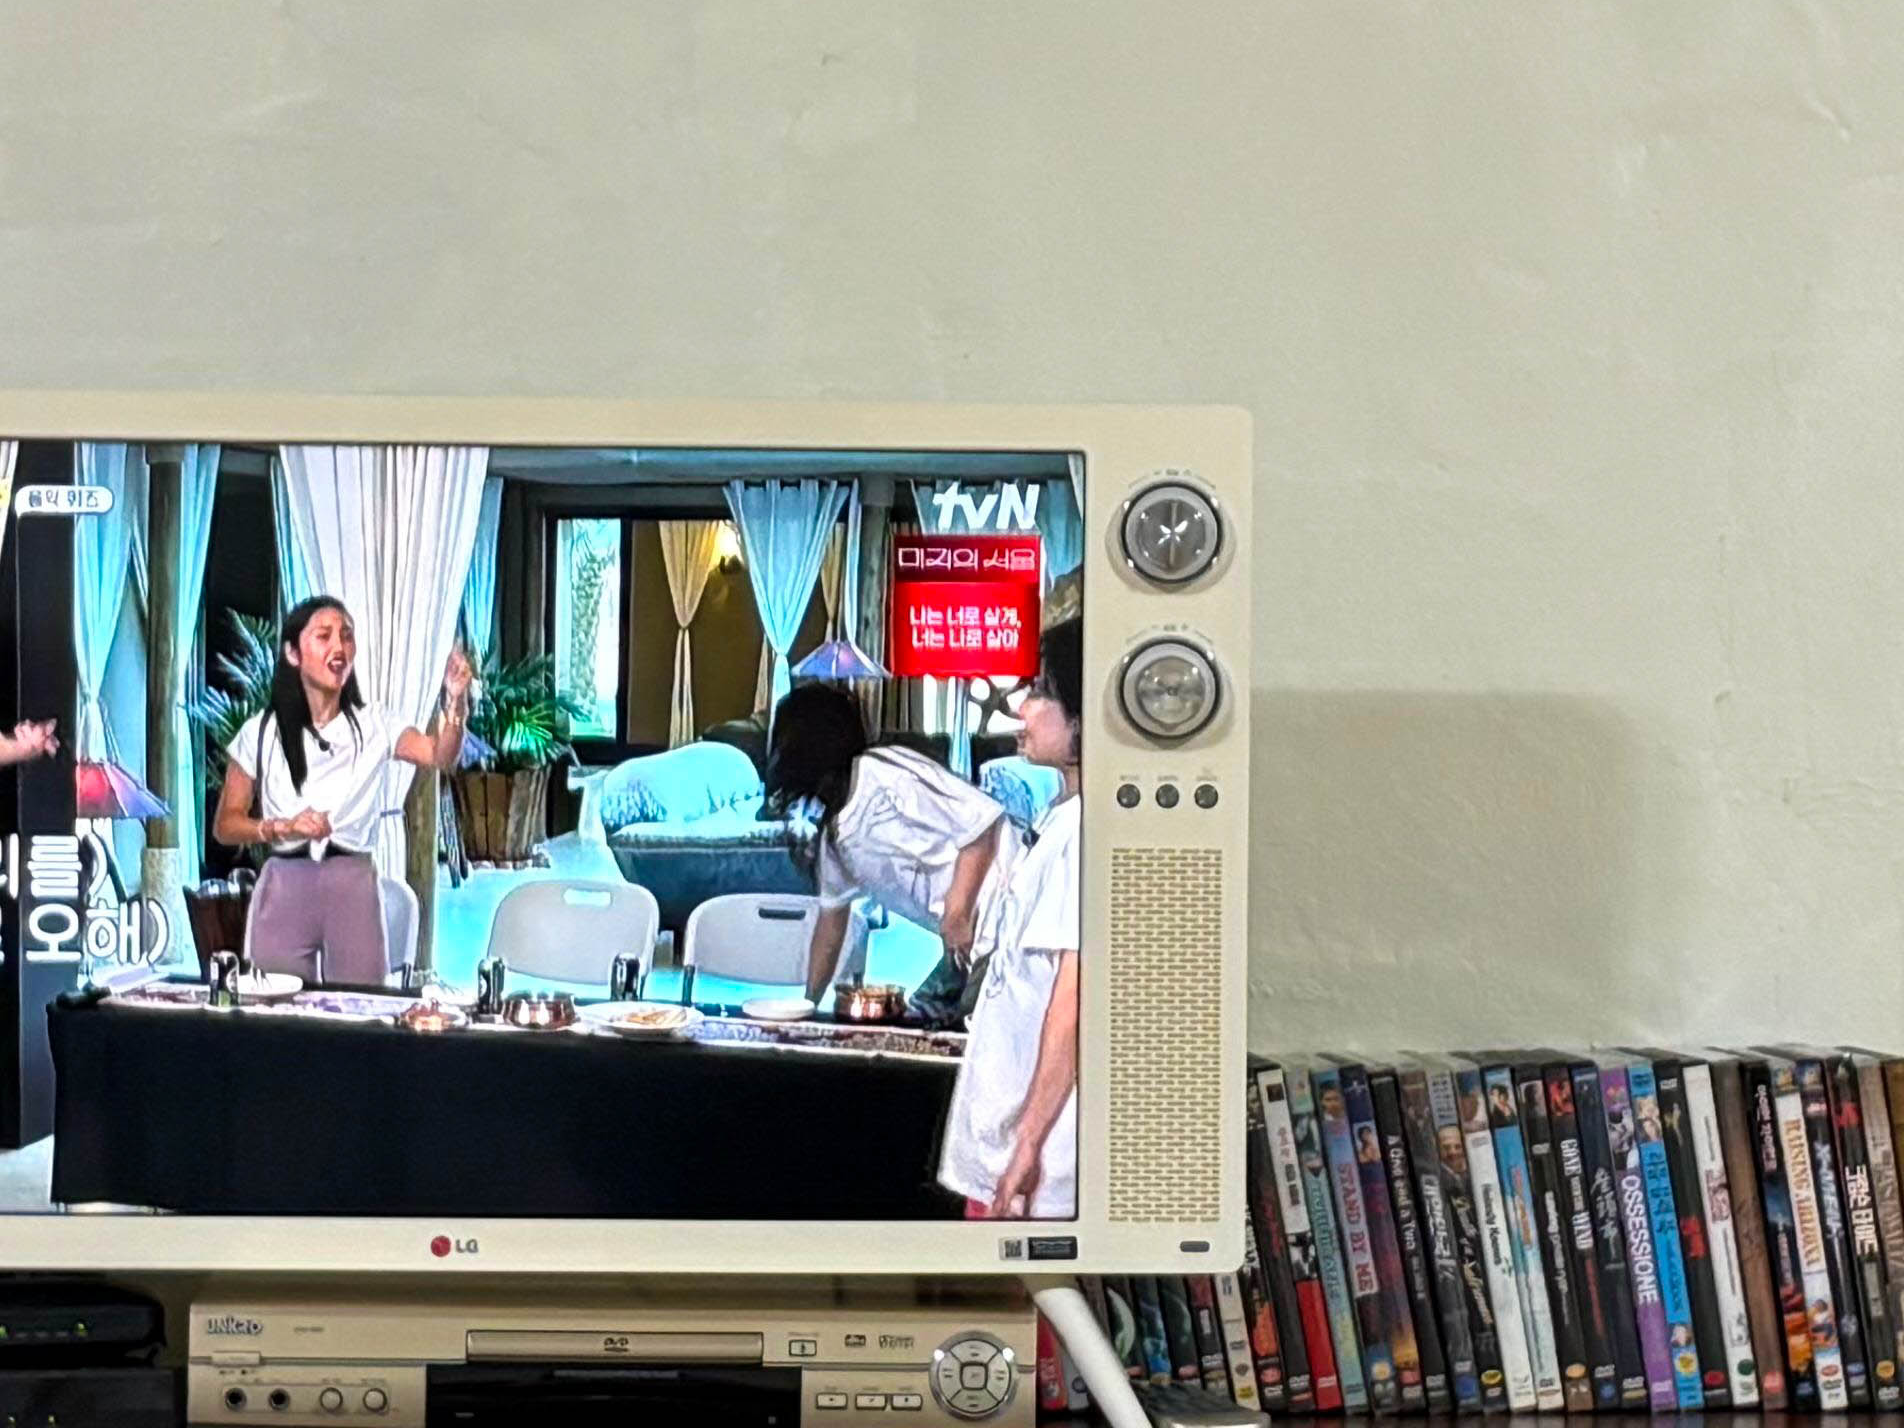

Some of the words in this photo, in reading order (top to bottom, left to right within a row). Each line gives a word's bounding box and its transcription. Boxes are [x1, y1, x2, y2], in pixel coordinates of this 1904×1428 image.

[933, 481, 1040, 531] tvN
[24, 899, 170, 966] 오해)
[1559, 1139, 1583, 1175] GONE
[1783, 1118, 1812, 1190] RAISING
[1338, 1163, 1363, 1224] STAND
[456, 1240, 478, 1255] LG
[1348, 1230, 1366, 1254] BY
[1401, 1220, 1418, 1251] Two
[1570, 1211, 1595, 1251] WIND
[1620, 1175, 1659, 1306] OSSESSIONE
[1793, 1192, 1822, 1268] ARIZONA
[1354, 1264, 1374, 1293] ME
